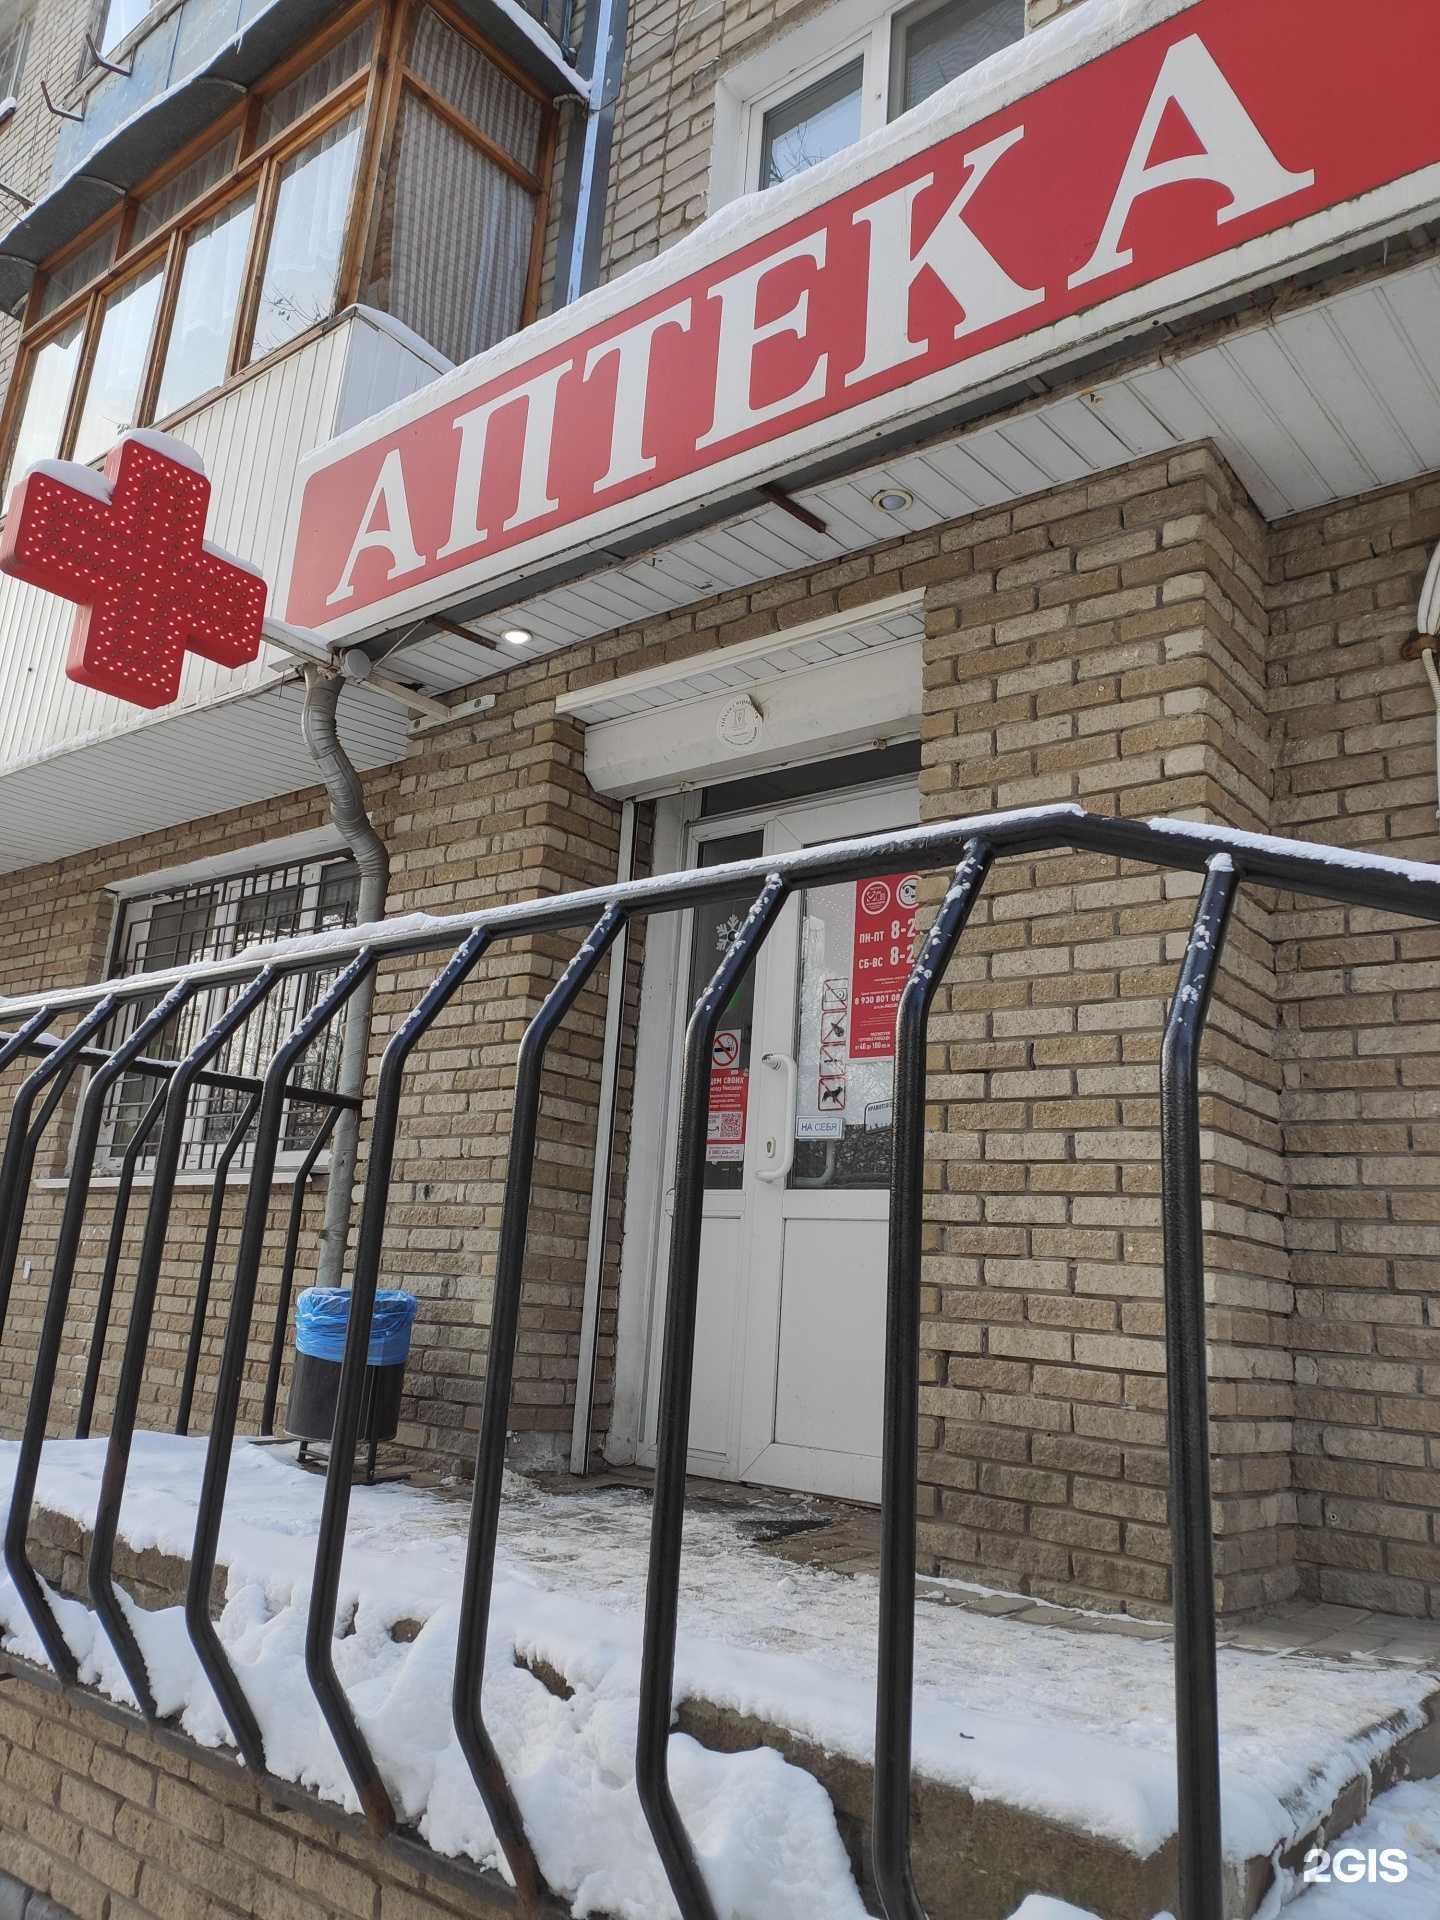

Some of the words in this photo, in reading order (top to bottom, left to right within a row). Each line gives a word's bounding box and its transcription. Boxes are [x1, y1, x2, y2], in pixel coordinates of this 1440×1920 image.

[327, 33, 1315, 606] АПТЕКА
[860, 931, 884, 944] ПН-ПТ
[891, 918, 916, 938] 8-2
[859, 957, 883, 969] СБ-ВС
[890, 944, 915, 965] 8-2
[801, 1122, 813, 1131] НА
[814, 1122, 838, 1131] СЕБЯ
